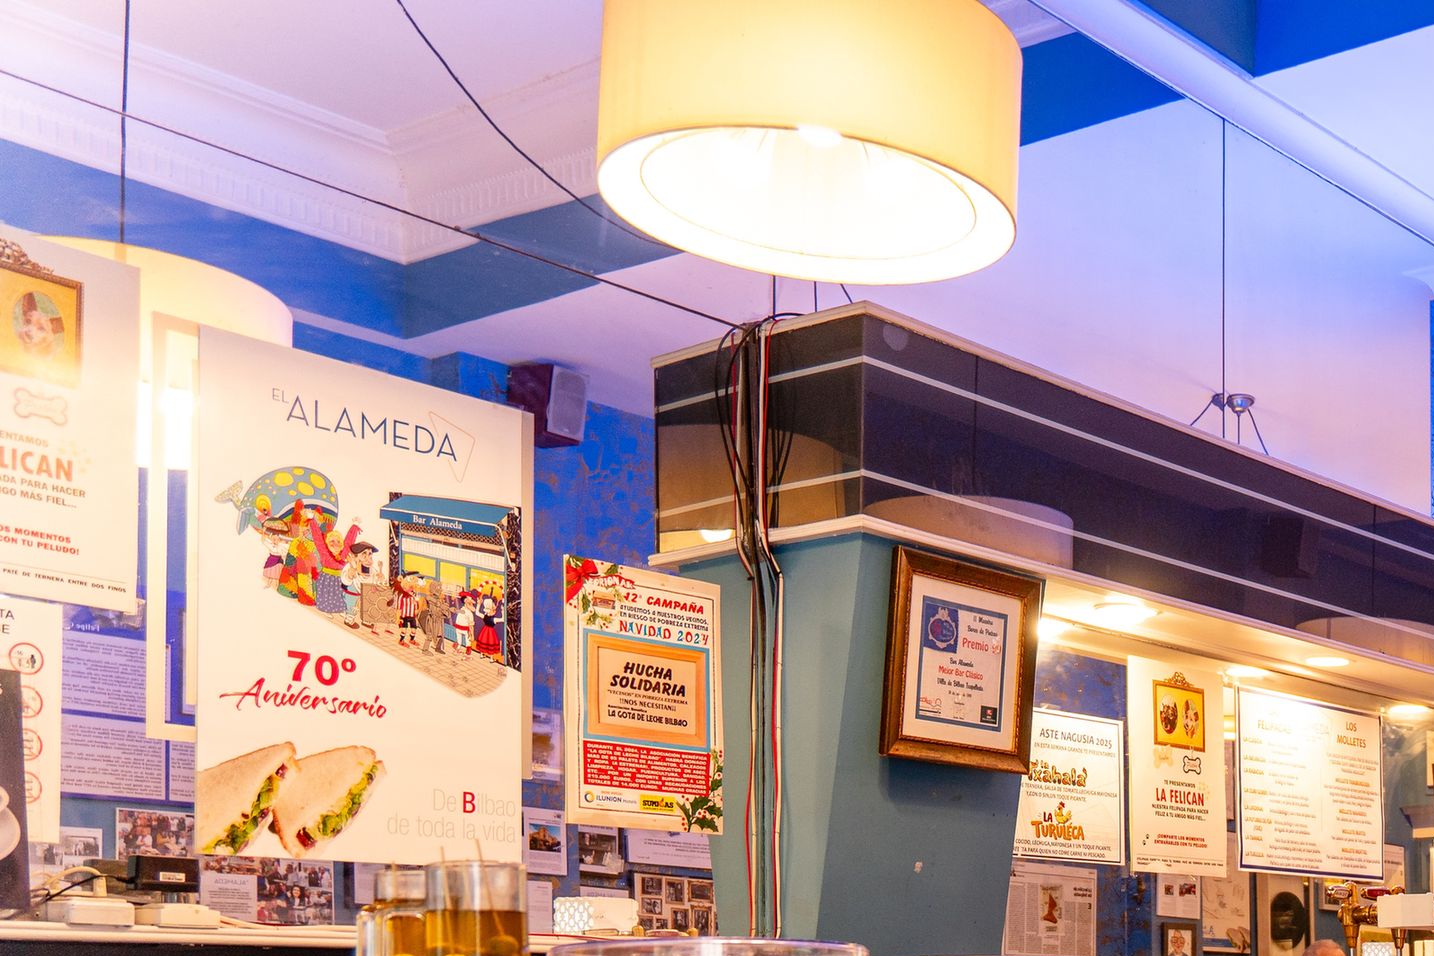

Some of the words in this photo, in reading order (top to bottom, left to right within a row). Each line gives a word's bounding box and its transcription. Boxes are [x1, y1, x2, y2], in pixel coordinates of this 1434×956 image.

[272, 388, 289, 404] EL
[287, 395, 458, 462] ALAMEDA
[21, 478, 48, 490] PARA
[52, 484, 86, 498] HACER
[413, 514, 428, 525] Bar
[430, 517, 463, 530] Alameda
[14, 527, 71, 544] MOMENTOS
[21, 537, 33, 548] TU
[36, 541, 80, 556] PELUDO!
[67, 578, 88, 587] ENTRE
[620, 605, 650, 615] AYUDEMOS
[657, 612, 684, 621] NUESTROS
[647, 596, 704, 614] CAMPAÑA
[628, 612, 648, 621] RIESGO
[658, 617, 682, 627] POBREZA
[684, 622, 708, 631] EXTREMA
[620, 620, 671, 639] NAVIDAD
[677, 631, 709, 645] 2024
[962, 638, 988, 651] Premio
[624, 662, 672, 680] HUCHA
[955, 668, 963, 676] Bar
[610, 675, 686, 697] SOLIDARIA
[219, 677, 388, 718] Aniversario
[617, 711, 635, 720] GOTA
[646, 715, 663, 724] LECHE
[665, 717, 687, 727] BILBAO
[1346, 722, 1357, 732] LOS
[1040, 729, 1059, 740] ASTE
[1061, 731, 1094, 744] NAGUSIA
[1096, 738, 1112, 749] 2025
[1337, 735, 1366, 748] MOLLETES
[433, 788, 457, 813] De
[462, 791, 517, 818] Bilbao
[1156, 788, 1166, 802] LA
[1170, 789, 1204, 806] FELICAN
[1044, 812, 1052, 822] LA
[387, 813, 411, 835] de
[413, 816, 456, 839] toda
[462, 817, 477, 840] la
[482, 820, 517, 842] vida
